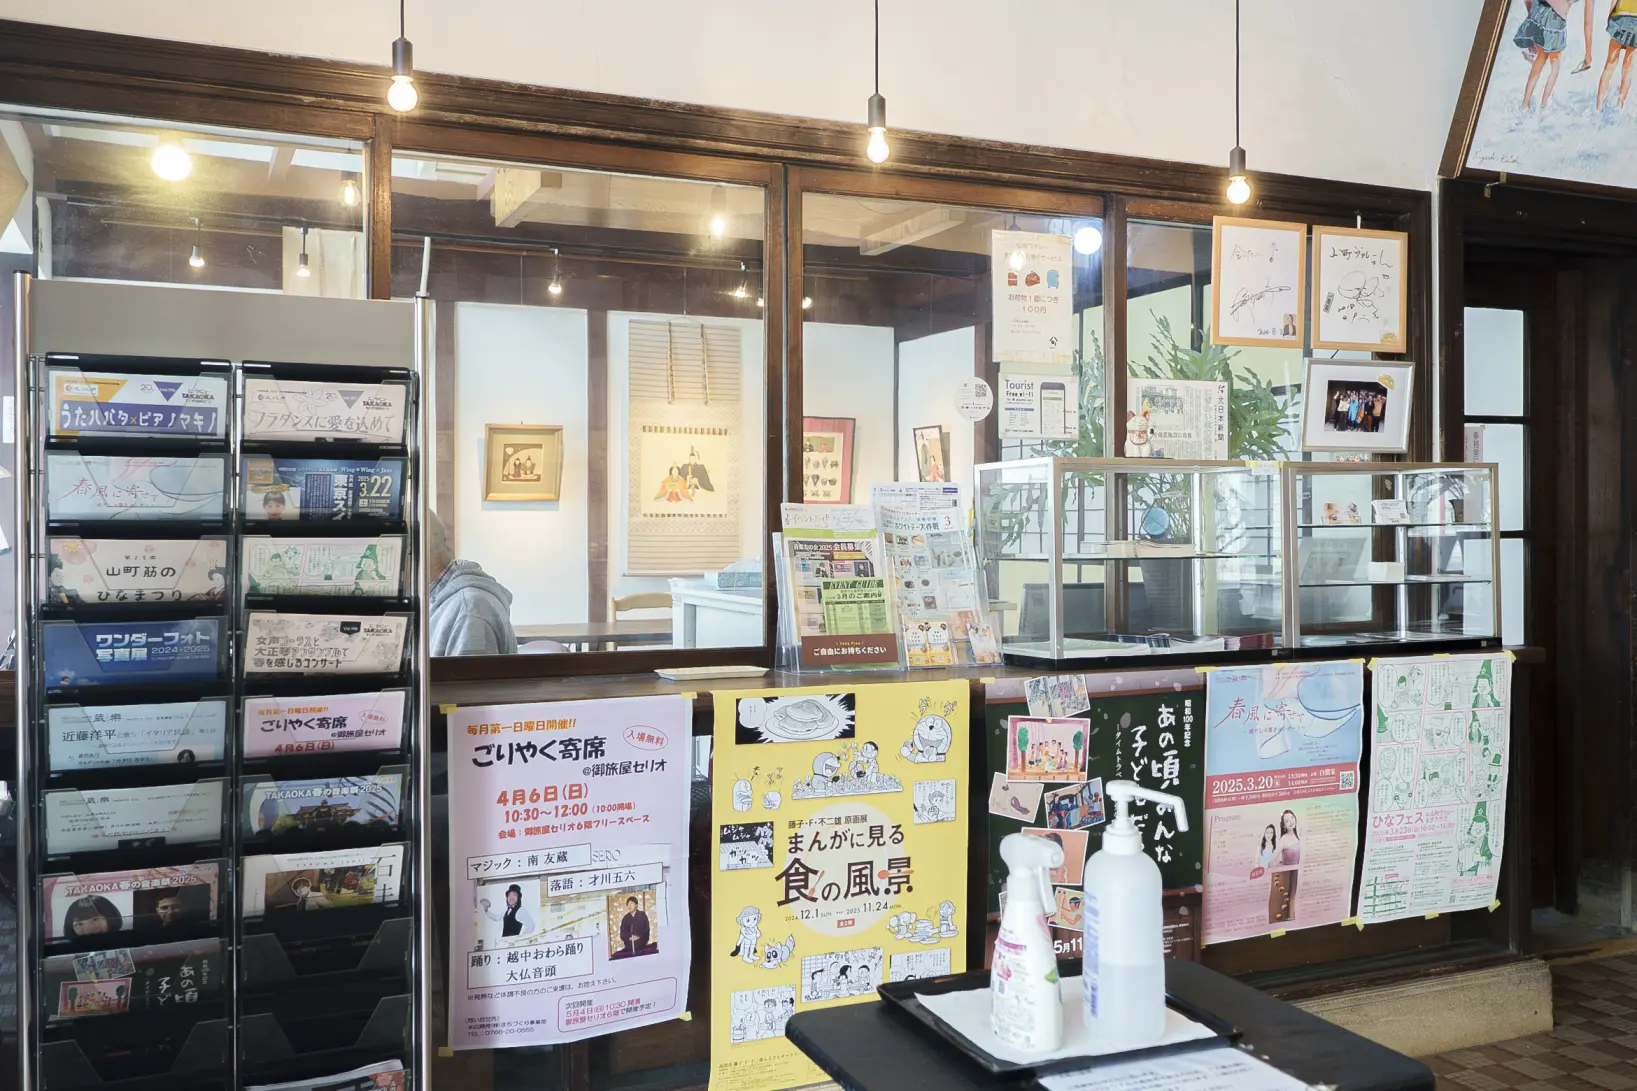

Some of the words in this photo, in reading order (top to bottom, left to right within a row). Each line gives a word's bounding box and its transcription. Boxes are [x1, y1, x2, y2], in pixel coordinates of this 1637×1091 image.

[1004, 379, 1034, 390] Tourist
[106, 566, 176, 578] 山町筋の
[97, 589, 182, 601] ひなまつり
[96, 632, 210, 648] ワンダーフォト
[96, 648, 148, 662] 写真展
[813, 646, 887, 656] ご自由にお持ちください
[254, 658, 342, 668] 春を感じるコンサート
[1213, 697, 1304, 729] 春風に寄せて
[260, 716, 348, 733] ごりやく寄席
[466, 719, 577, 735] 毎月第一日曜日開催!!
[1183, 699, 1193, 748] 昭和100年記念
[626, 730, 665, 746] 入場無料
[472, 736, 607, 768] ごりやく寄席
[582, 759, 667, 778] @御旅屋セリオ
[1212, 775, 1273, 794] 2025.3.20
[496, 783, 589, 806] 4月6日(日)
[844, 814, 868, 824] 原画展
[1214, 815, 1241, 823] Program
[1372, 811, 1424, 829] ひなフェス
[787, 824, 904, 854] まんがに見る
[774, 856, 914, 907] 食の風景
[800, 908, 819, 920] 12.1
[863, 901, 889, 913] 11.24
[506, 965, 557, 982] 大仏音頭
